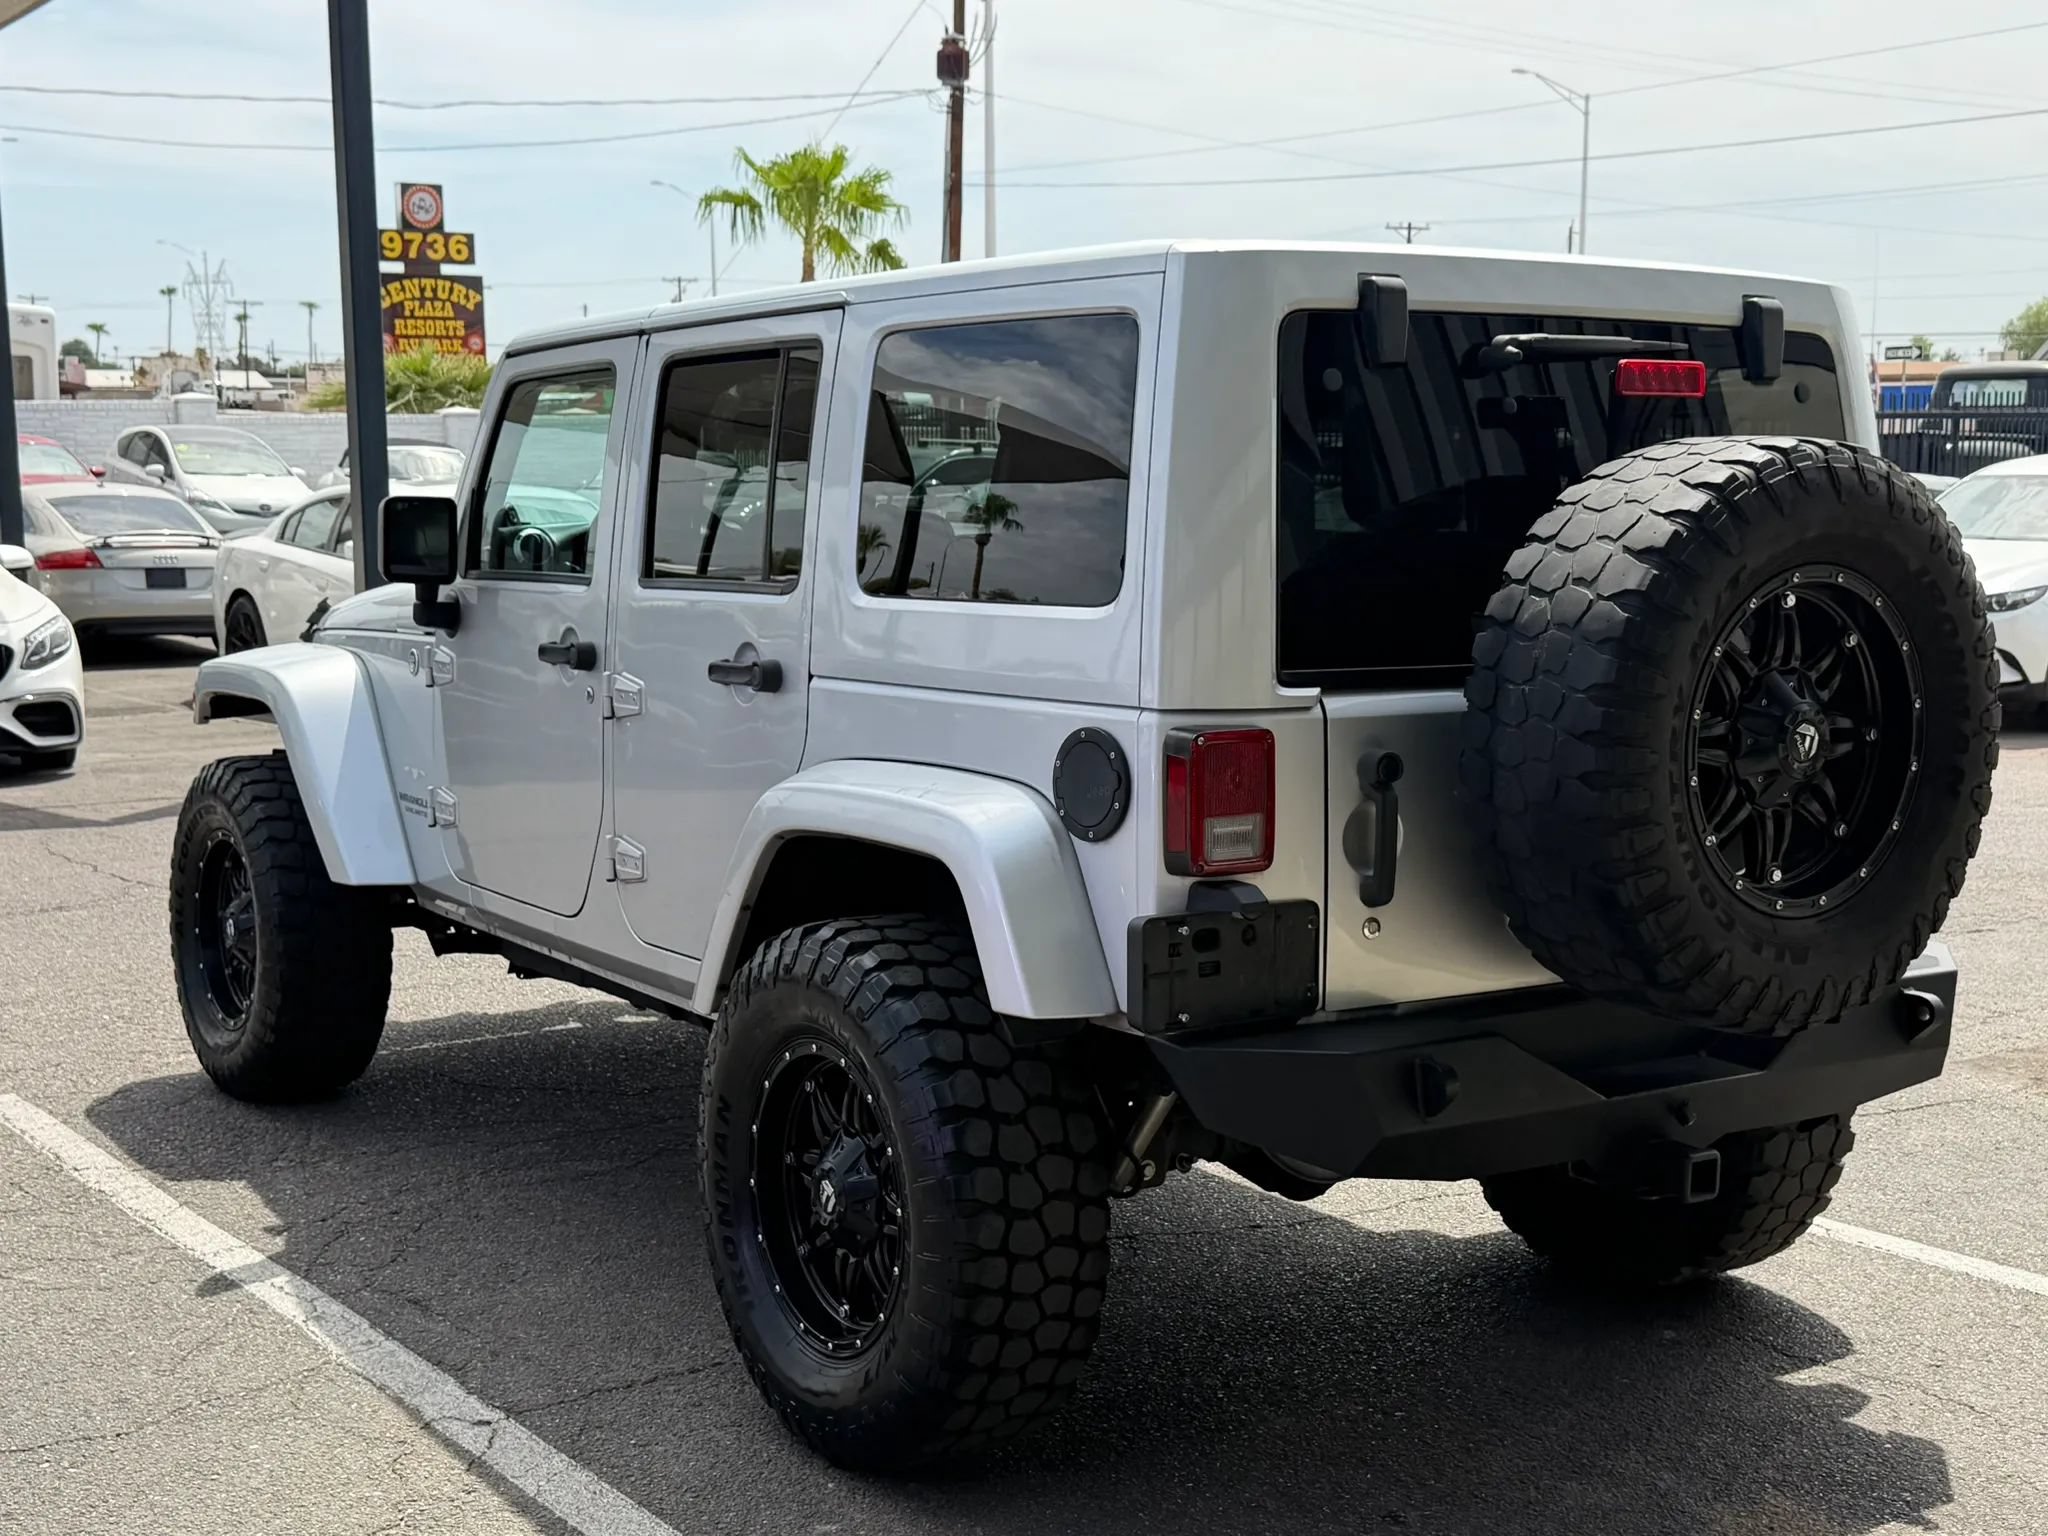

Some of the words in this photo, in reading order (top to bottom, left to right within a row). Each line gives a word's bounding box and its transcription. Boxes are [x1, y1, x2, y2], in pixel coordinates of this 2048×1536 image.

[381, 231, 469, 262] 9736
[403, 300, 454, 318] PLAZA
[394, 318, 465, 337] RESORTS
[398, 338, 419, 352] RV
[425, 338, 463, 352] ARK
[1793, 733, 1808, 761] FUEL
[715, 1094, 755, 1311] IRONMAN
